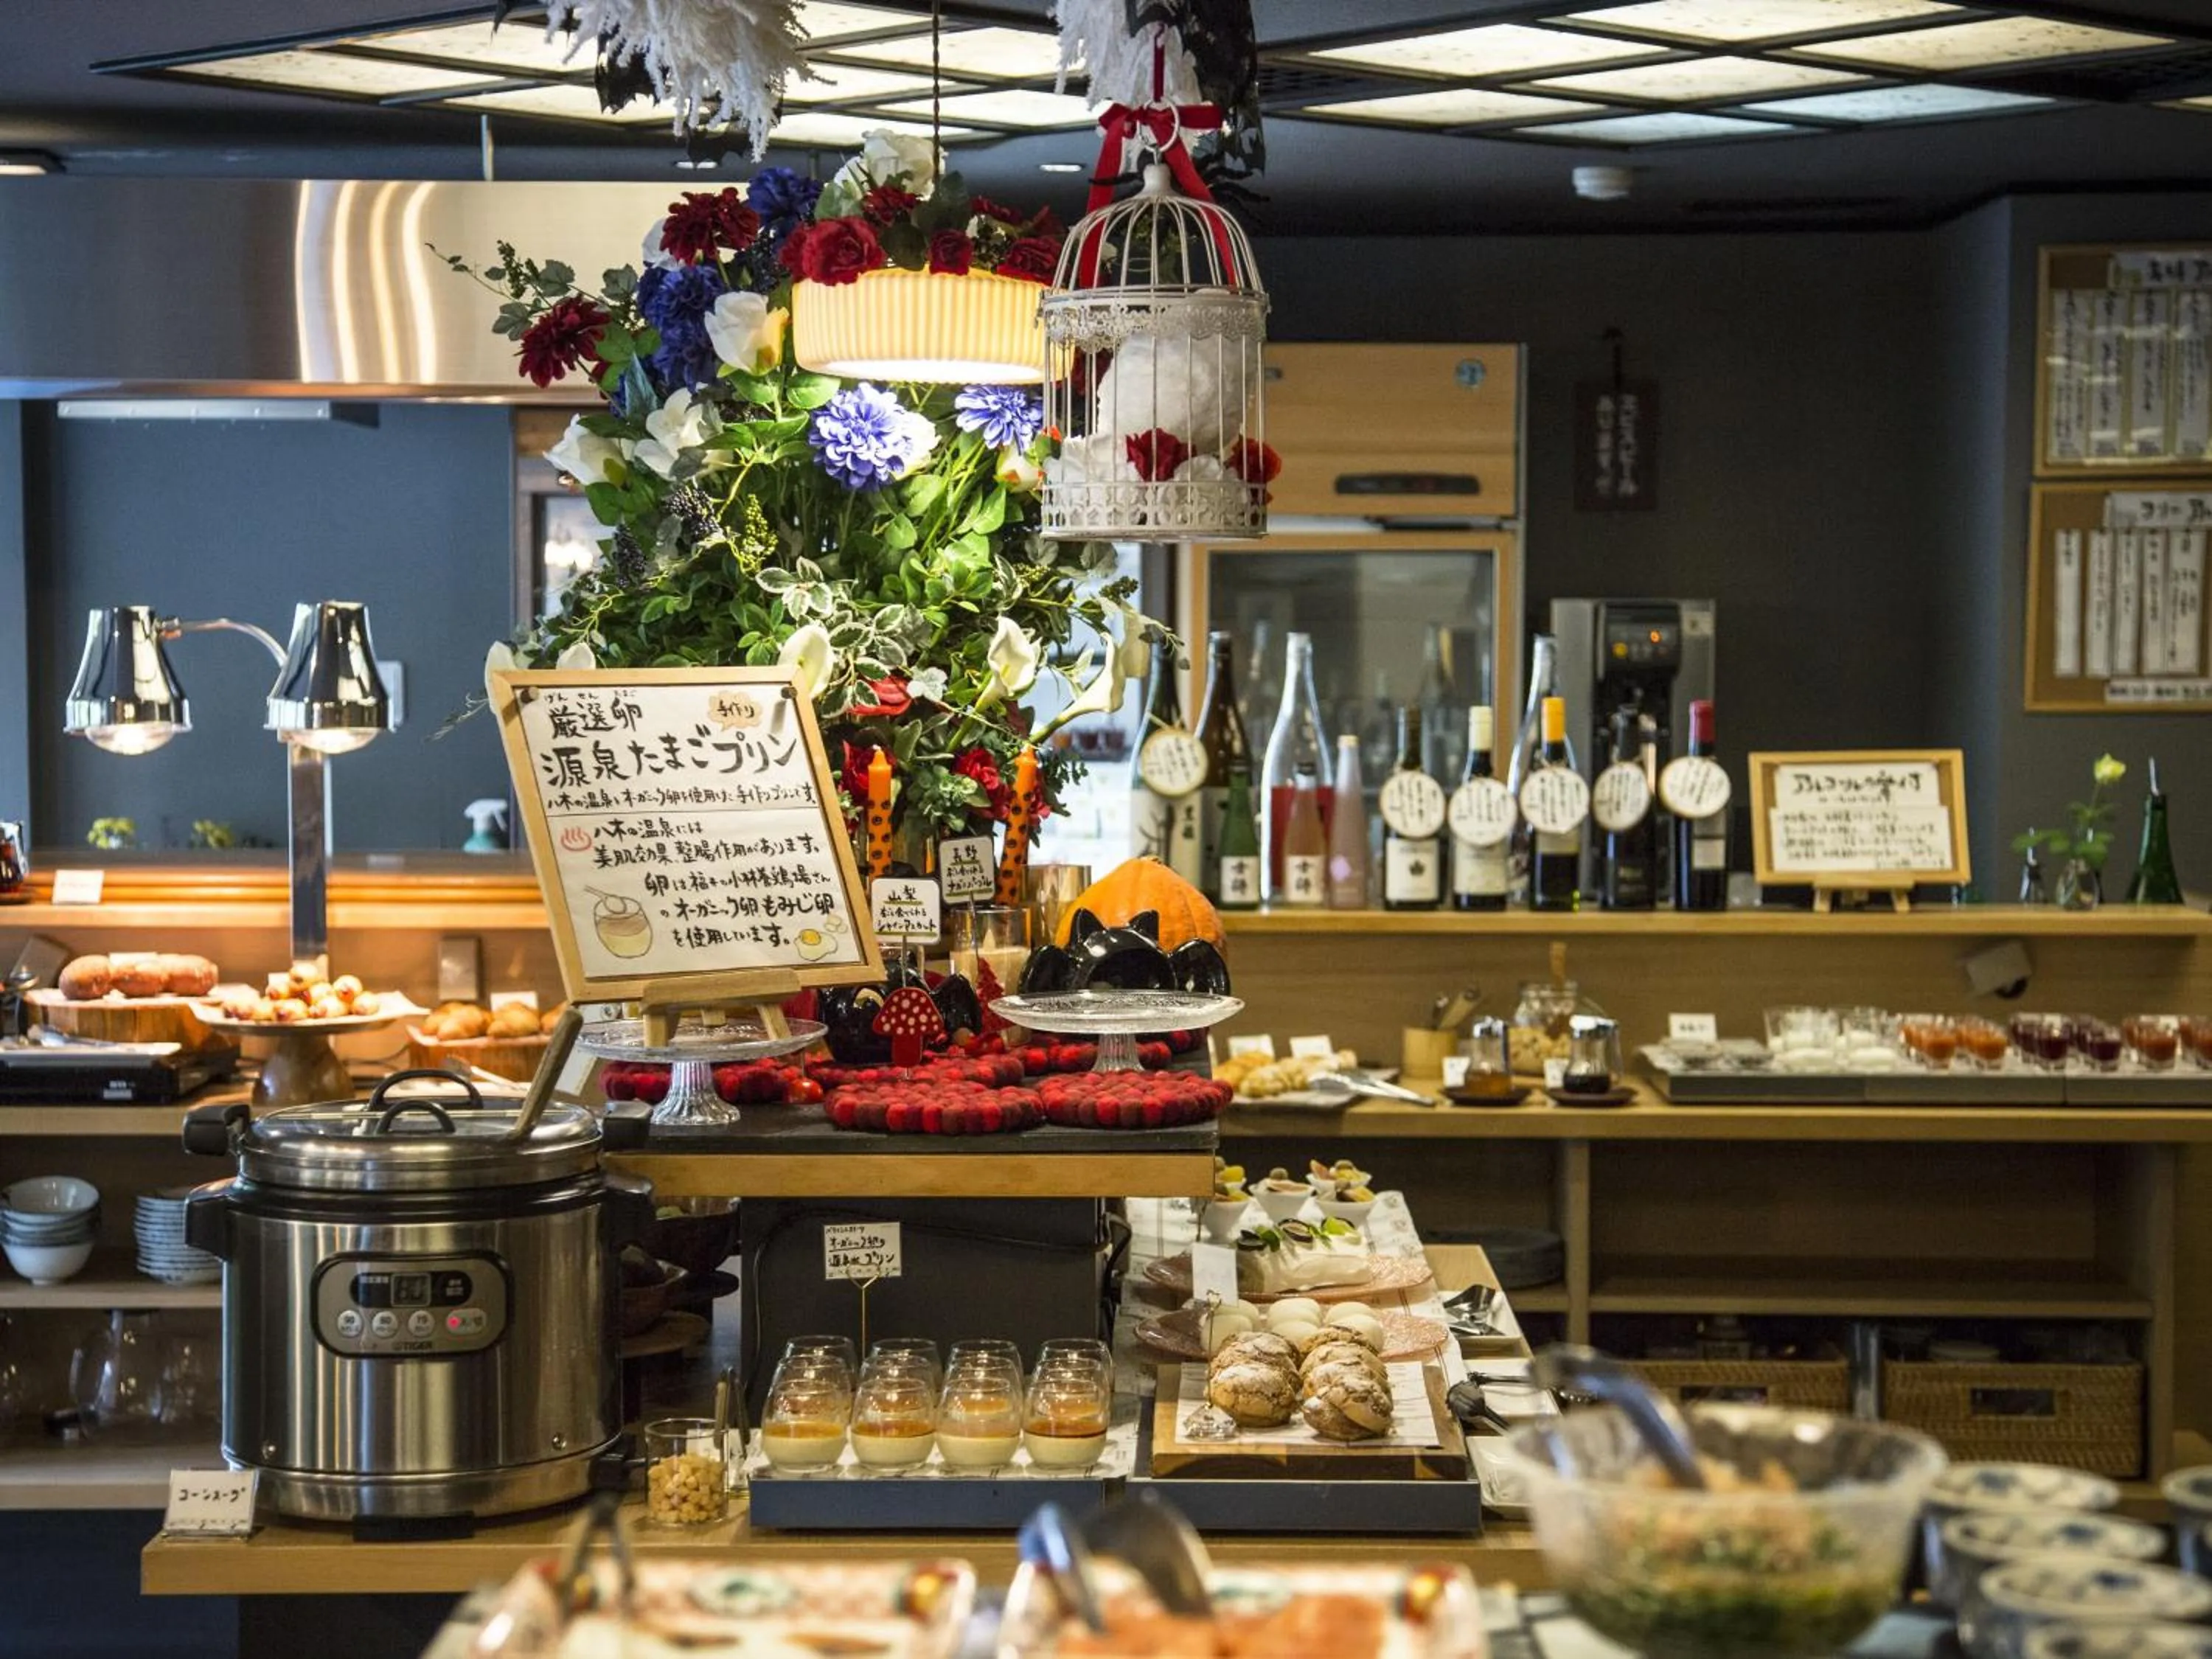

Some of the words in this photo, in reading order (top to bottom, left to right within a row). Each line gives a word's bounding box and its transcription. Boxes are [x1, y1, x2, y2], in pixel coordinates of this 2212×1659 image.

[549, 697, 643, 739] 厳選卵
[717, 700, 755, 719] 手作り
[540, 723, 797, 787] 源泉たまごプリン
[594, 817, 702, 841] 八木の温泉には
[953, 845, 978, 862] 長野
[888, 885, 917, 900] 山梨
[877, 919, 936, 932] シャインマスカット
[178, 1486, 246, 1503] コーンスープ
